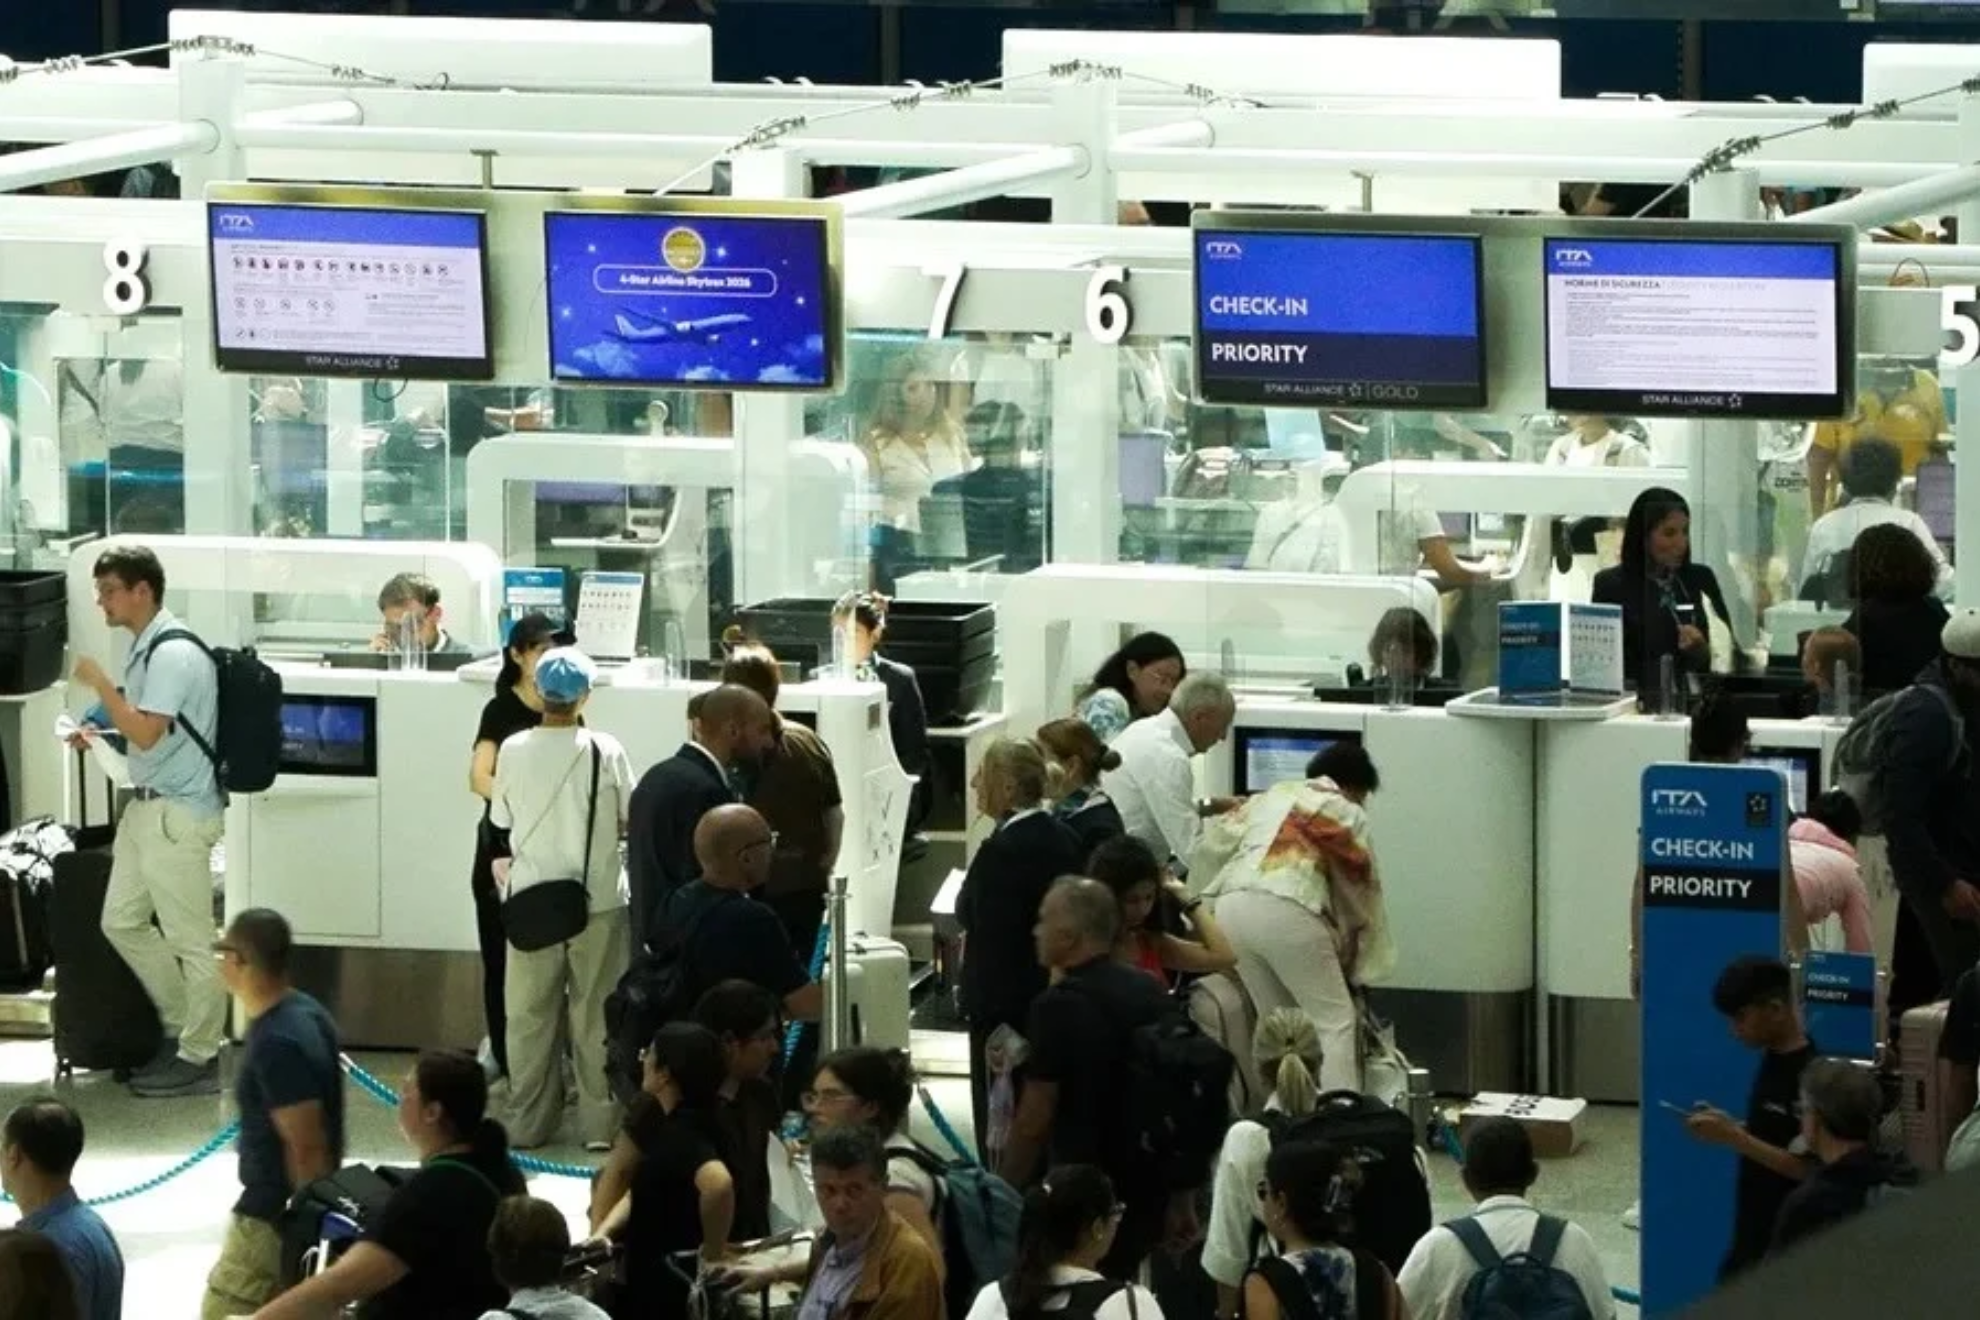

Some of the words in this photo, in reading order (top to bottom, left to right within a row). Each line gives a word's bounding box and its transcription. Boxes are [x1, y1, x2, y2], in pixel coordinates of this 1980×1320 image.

[103, 238, 149, 314] 8
[652, 275, 685, 286] Airline
[921, 265, 966, 339] 7
[1086, 266, 1132, 344] 6
[1209, 295, 1308, 317] CHECK-IN
[1939, 285, 1980, 366] 5
[1211, 343, 1308, 364] PRIORITY
[1264, 383, 1292, 394] STAR
[1294, 385, 1344, 396] ALLIANCE
[1372, 385, 1419, 399] GOLD
[1642, 394, 1671, 405] STAR
[1672, 395, 1724, 407] ALLIANCE
[1652, 789, 1708, 807] ITA
[1656, 807, 1706, 817] AIRWAYS
[1651, 837, 1755, 861] CHECK-IN
[1650, 875, 1752, 898] PRIORITY
